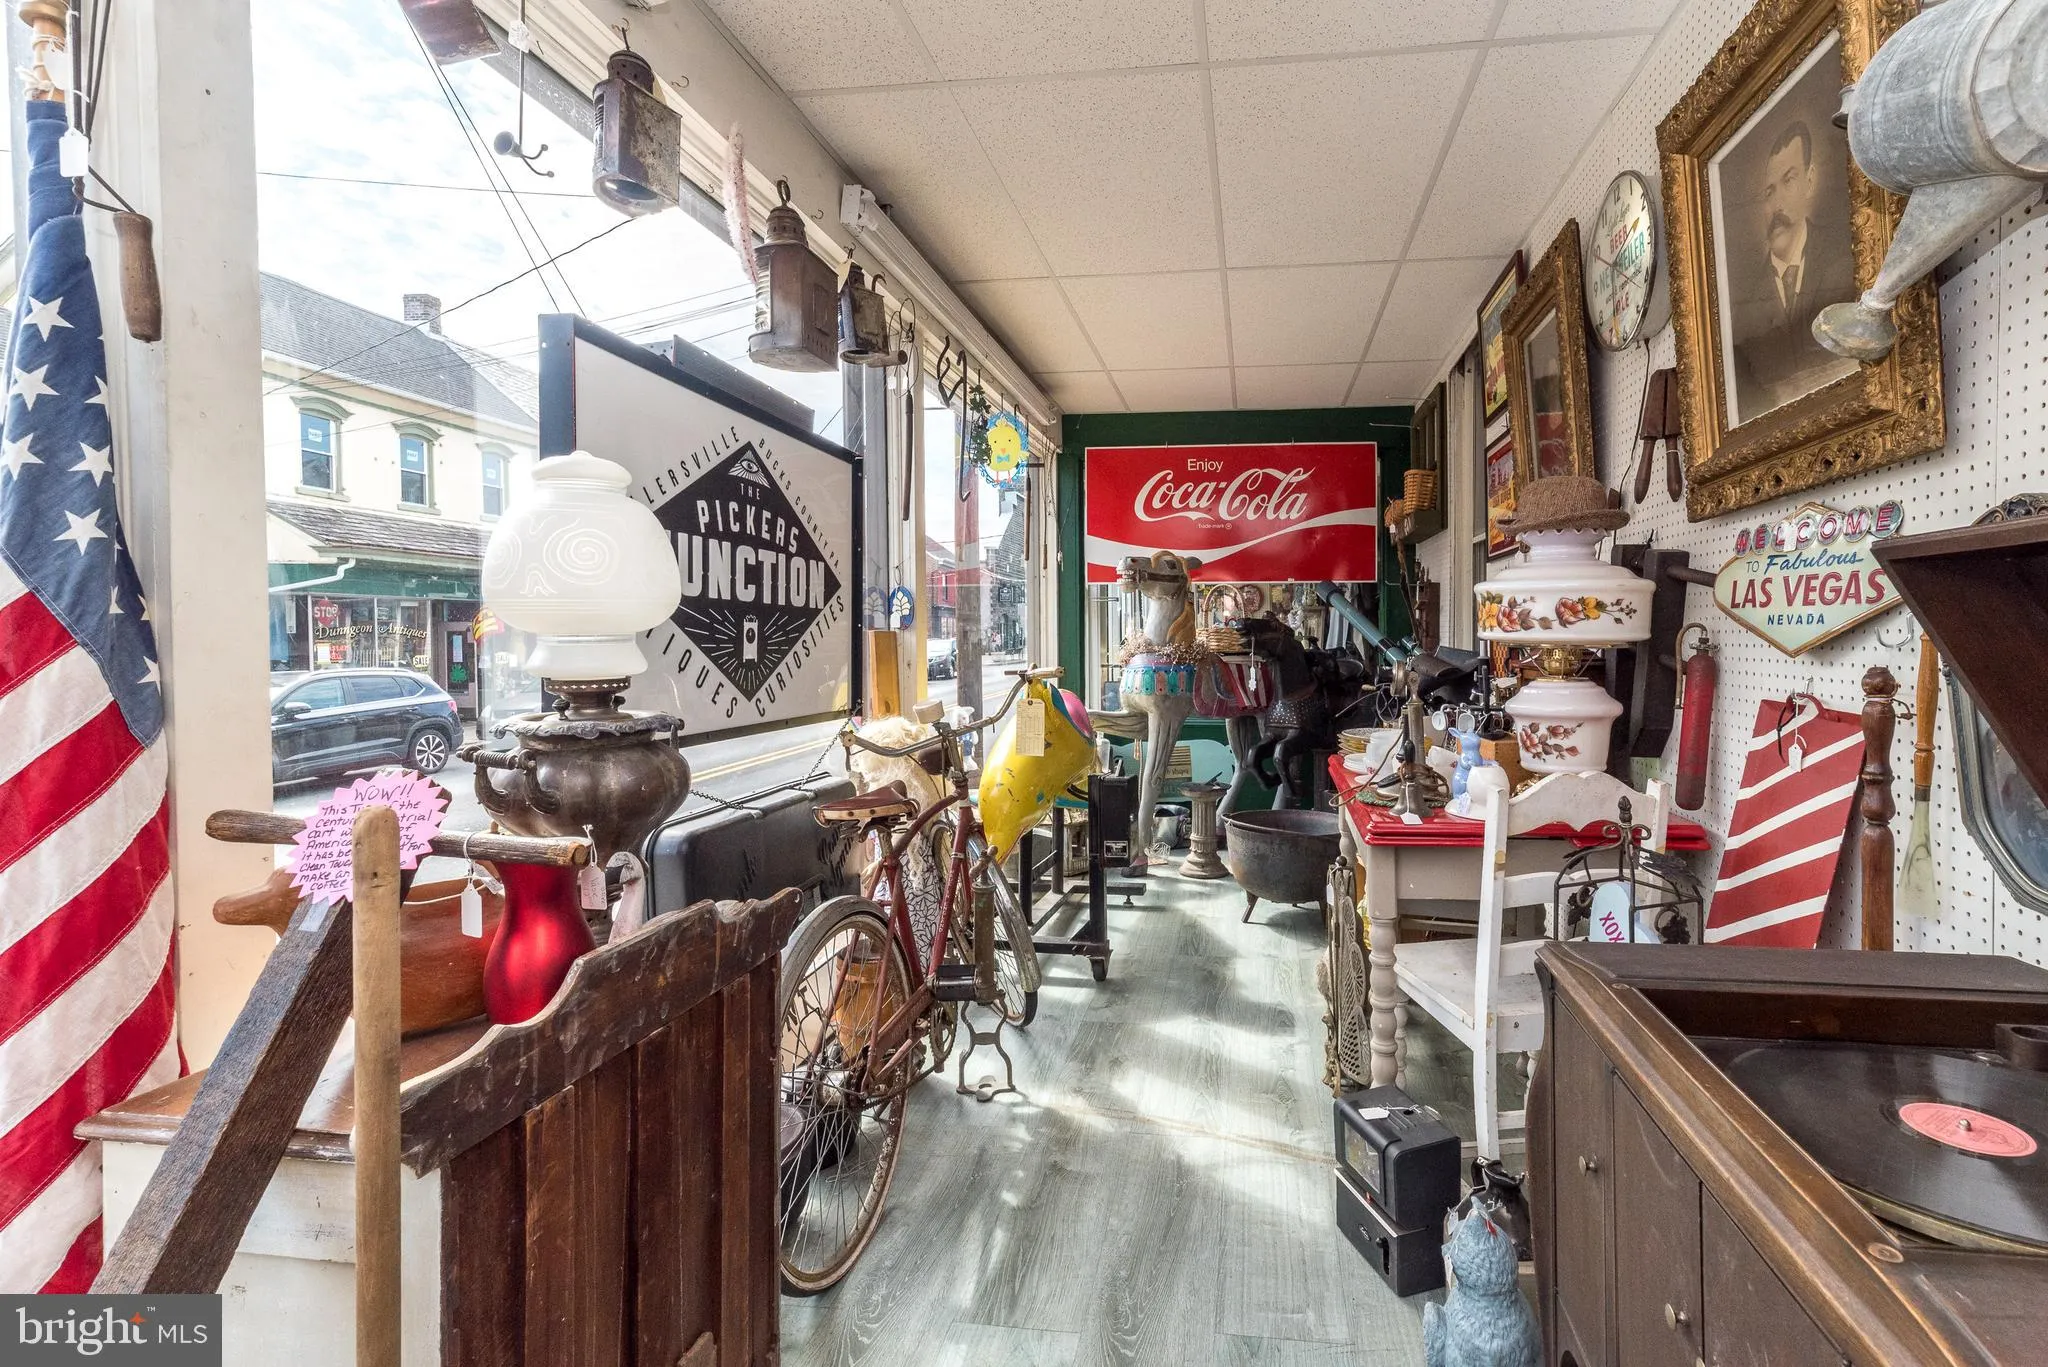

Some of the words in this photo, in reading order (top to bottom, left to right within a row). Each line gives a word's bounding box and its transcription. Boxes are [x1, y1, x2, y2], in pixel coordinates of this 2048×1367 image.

[1610, 223, 1628, 254] BEER
[629, 426, 740, 504] LERSVILLE
[1187, 458, 1224, 472] Enjoy
[741, 483, 760, 500] THE
[759, 438, 792, 491] BUCKS
[795, 495, 829, 549] COUNTY
[1134, 466, 1317, 522] Coca-Cola
[696, 500, 800, 554] PICKERS
[1736, 507, 1894, 553] WELCOME
[664, 529, 825, 610] UNCTION
[1746, 561, 1760, 573] TO
[1764, 548, 1864, 575] Fabulous
[1730, 576, 1773, 609] LAS
[1783, 568, 1888, 607] VEGAS
[378, 623, 428, 639] Antiques
[1767, 613, 1826, 626] NEVADA
[756, 595, 845, 718] CURIOSITIES
